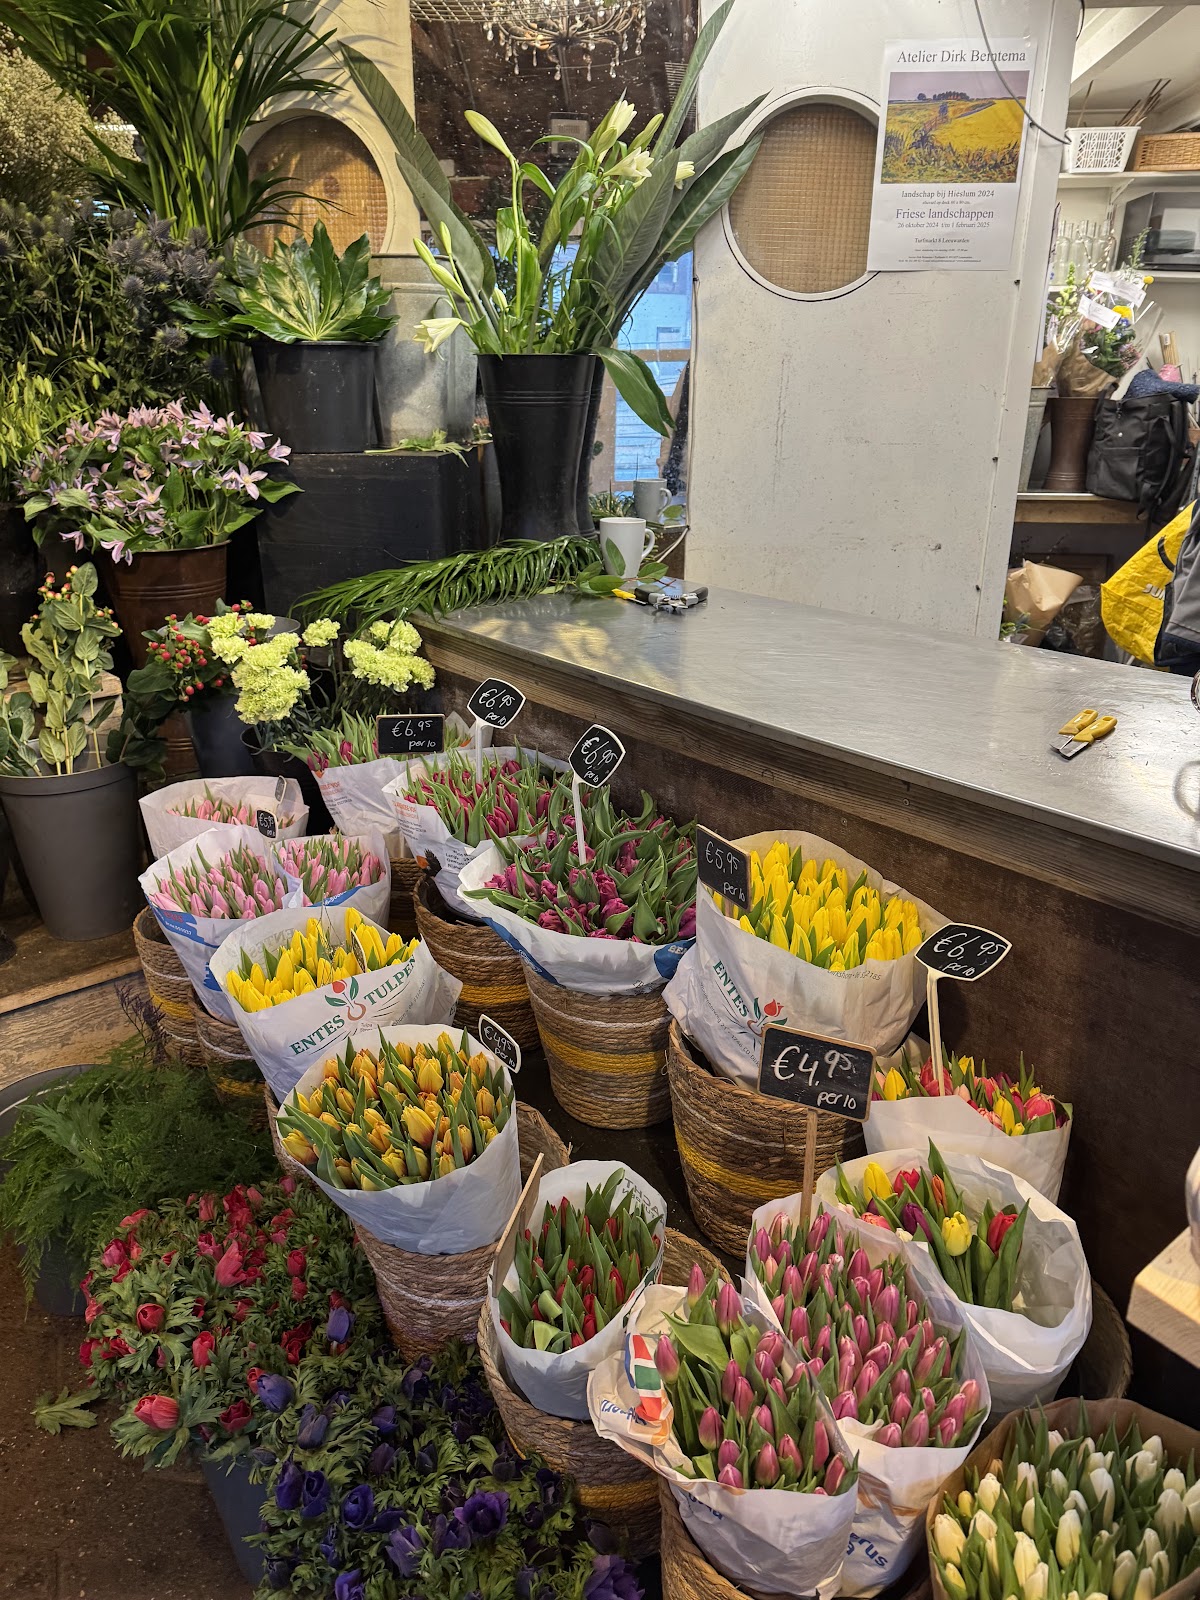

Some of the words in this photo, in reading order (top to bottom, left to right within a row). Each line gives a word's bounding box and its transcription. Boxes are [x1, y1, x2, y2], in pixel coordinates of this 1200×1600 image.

[897, 50, 937, 63] Atelier
[941, 50, 967, 62] Dirk
[901, 190, 935, 199] landschap
[936, 190, 946, 199] bij
[896, 208, 926, 219] Friese
[928, 208, 994, 221] landschappen
[409, 740, 426, 750] per
[723, 882, 738, 895] per
[713, 960, 750, 1018] ENTES
[289, 1014, 345, 1056] ENTES
[363, 954, 416, 1006] TULPEN
[817, 1091, 843, 1107] per
[843, 1094, 857, 1110] 10
